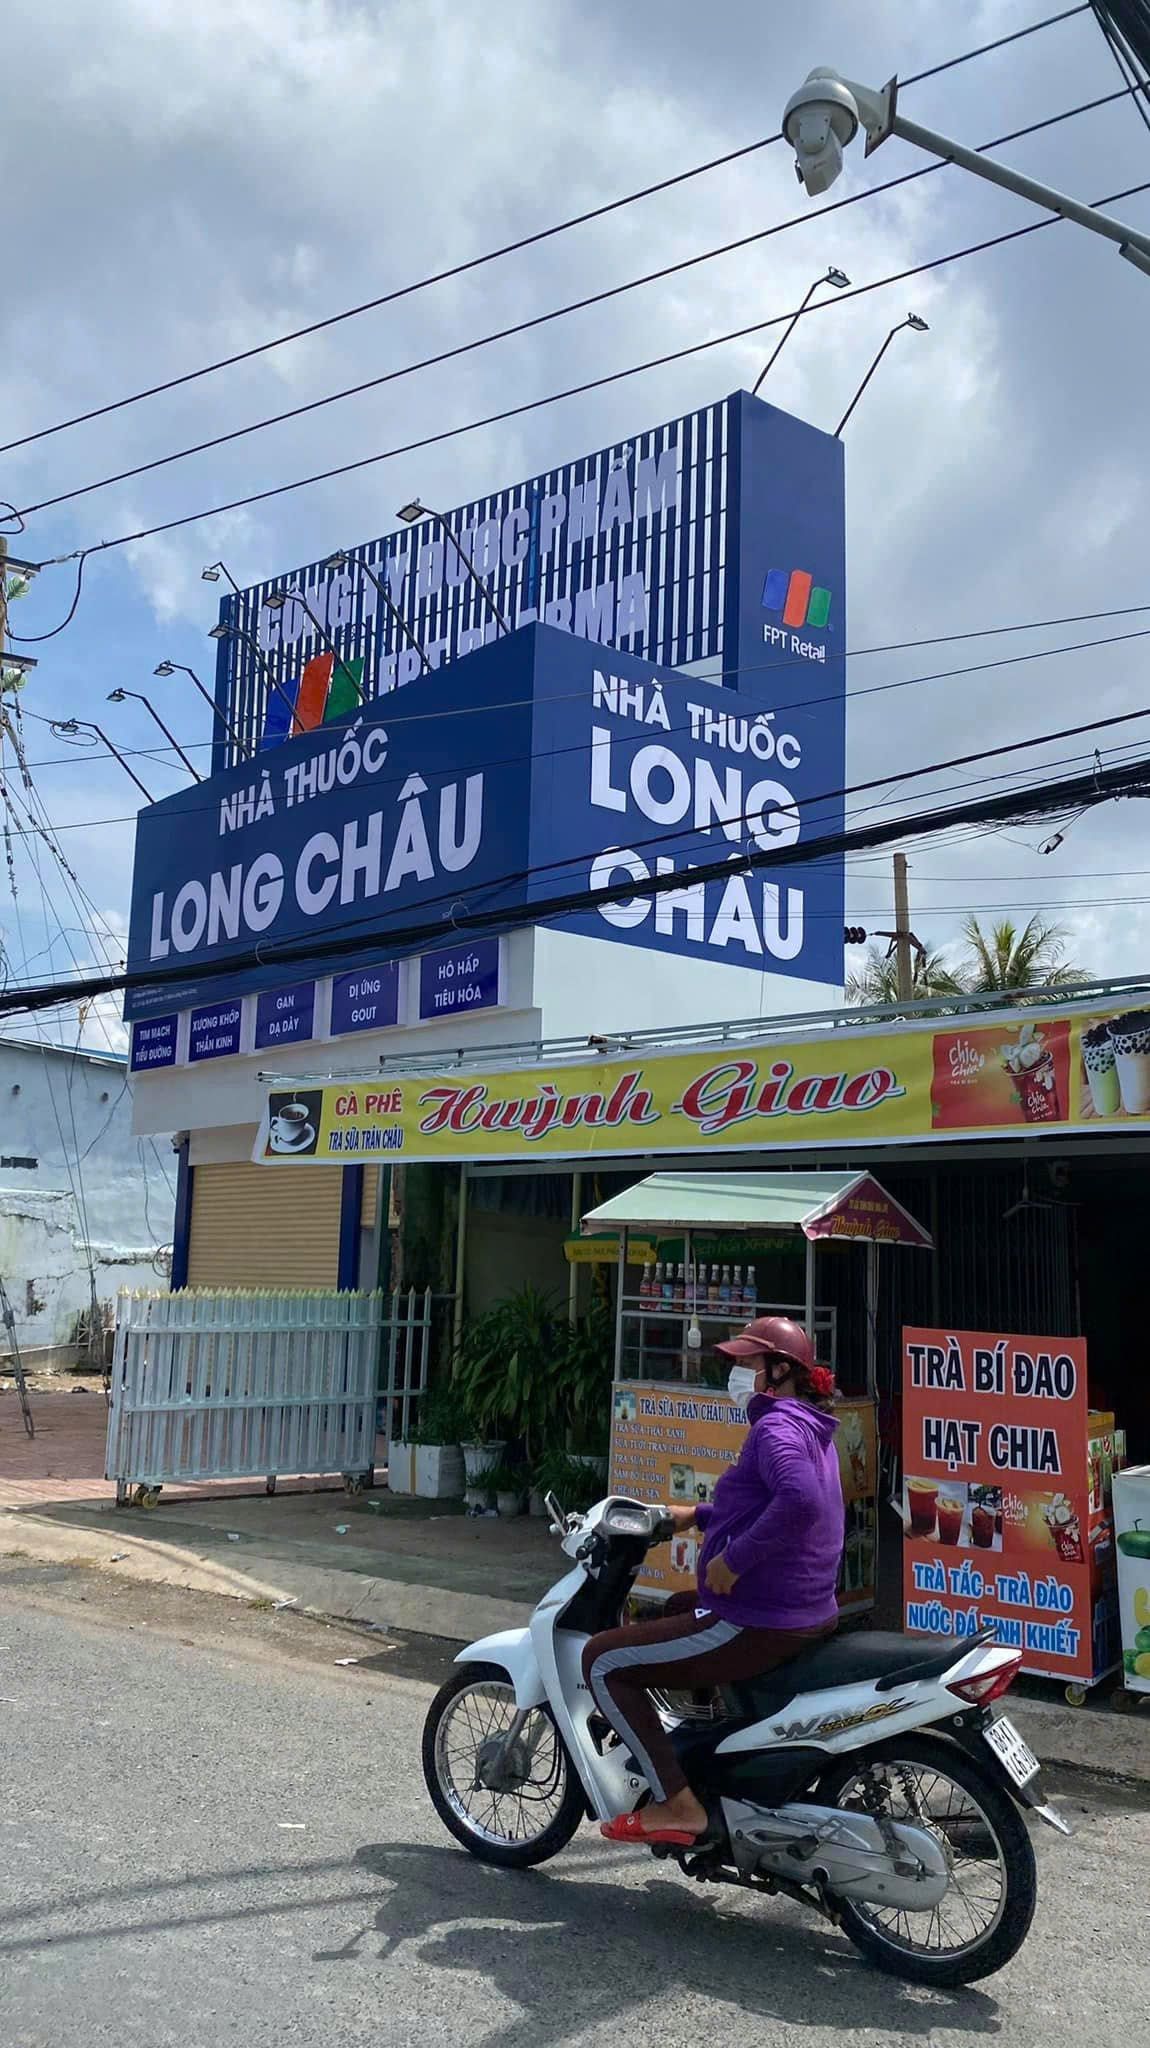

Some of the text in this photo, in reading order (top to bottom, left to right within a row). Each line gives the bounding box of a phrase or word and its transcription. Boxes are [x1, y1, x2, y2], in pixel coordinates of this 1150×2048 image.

[259, 446, 679, 650] CÔNG TY DƯỢC PHẨM
[763, 624, 826, 663] FPT Retail
[593, 670, 802, 770] NHÀ THUỐC
[219, 716, 389, 836] NHÀ THUỐC
[590, 726, 801, 851] LONG
[149, 772, 485, 961] LONG CHÂU
[589, 845, 804, 961] CHÂU
[438, 951, 480, 980] HÔ HẤP
[276, 995, 295, 1010] GAN
[349, 979, 381, 1000] DỊ ỨNG
[434, 984, 482, 1009] TIÊU HÓA
[140, 1024, 171, 1041] TIM MẠCH
[192, 1009, 240, 1033] XƯƠNG KHỚP
[269, 1022, 281, 1037] DẠ
[351, 1006, 377, 1023] GOUT
[215, 1035, 233, 1049] KINH
[335, 1087, 403, 1116] CÀ PHÊ
[418, 1060, 906, 1141] Huỳnh Giao
[328, 1125, 343, 1151] TRÀ
[344, 1125, 360, 1151] SỮA
[907, 1336, 1077, 1400] TRÀ BÍ ĐAO
[923, 1416, 1062, 1475] HẠT CHIA
[912, 1558, 947, 1593] TRÀ
[949, 1559, 984, 1599] TẮC
[995, 1571, 1032, 1607] TRÀ
[1034, 1575, 1074, 1613] ĐÀO
[907, 1599, 952, 1633] NƯỚC
[954, 1606, 979, 1637] ĐÁ
[1024, 1618, 1081, 1657] KHIẾT
